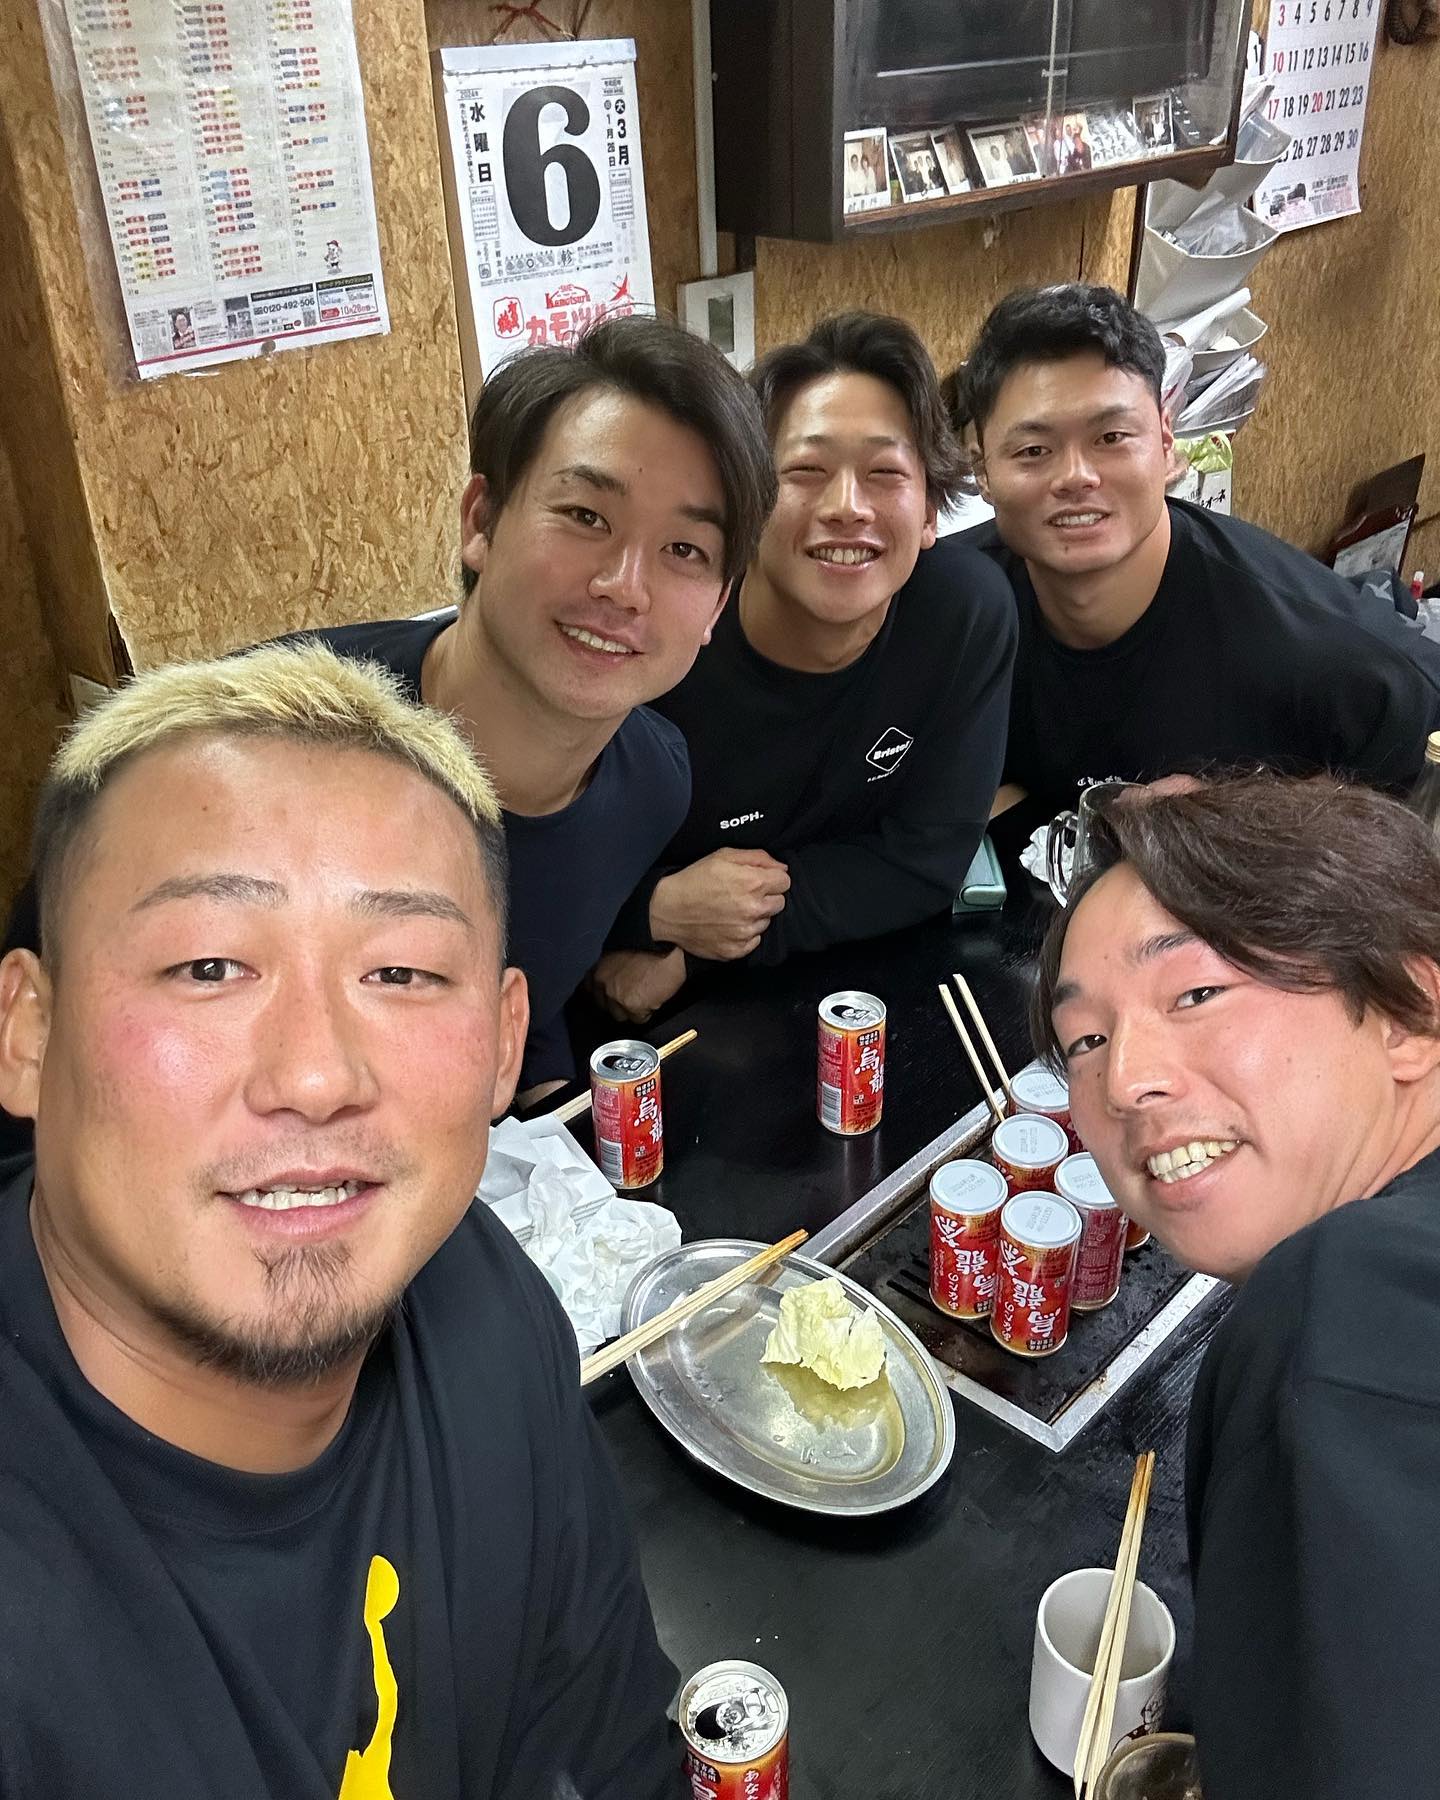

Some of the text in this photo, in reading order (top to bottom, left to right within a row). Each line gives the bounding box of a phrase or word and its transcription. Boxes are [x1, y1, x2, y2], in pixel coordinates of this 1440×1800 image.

[1278, 0, 1373, 27] 3 4 5 6 7 8 9
[1272, 40, 1369, 74] 10 11 12 13 14 15 16
[1267, 85, 1364, 121] 17 18 19 20 21 22 23
[469, 101, 493, 183] 水曜日
[1292, 139, 1303, 161] 26
[1306, 136, 1318, 158] 27
[1320, 134, 1332, 156] 28
[1334, 131, 1345, 153] 29
[1346, 128, 1359, 150] 30
[502, 85, 601, 247] 6
[872, 740, 911, 760] Bristol
[720, 811, 764, 830] SOPH.
